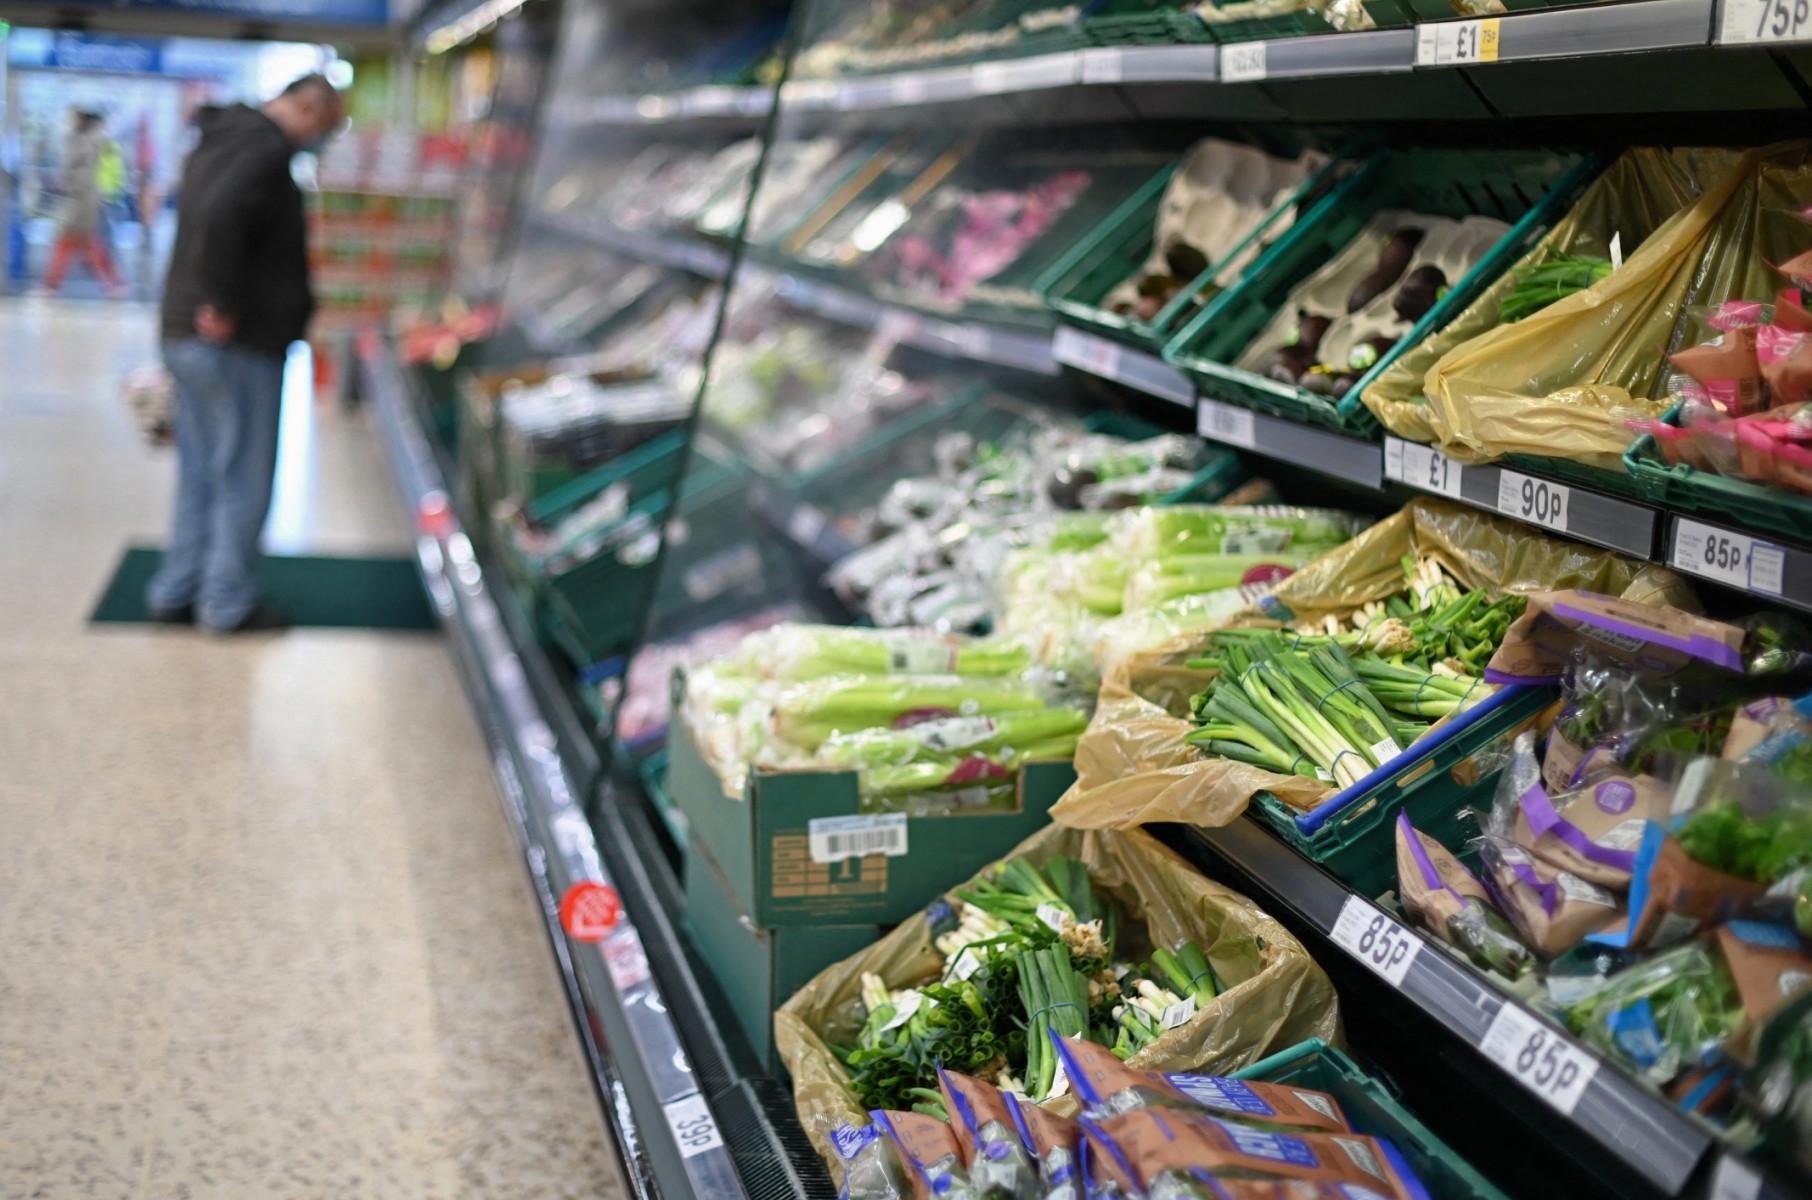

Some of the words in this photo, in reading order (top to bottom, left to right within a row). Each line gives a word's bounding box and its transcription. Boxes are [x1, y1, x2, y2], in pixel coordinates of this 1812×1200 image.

[1482, 30, 1496, 44] 75p
[1757, 0, 1809, 37] 75p
[1456, 25, 1477, 58] £1
[1429, 452, 1449, 491] £1
[1521, 478, 1562, 524] 90p
[1704, 534, 1742, 571] 85p
[1358, 914, 1409, 970] 85p
[1517, 1028, 1580, 1094] 85p
[677, 1114, 713, 1146] 39p
